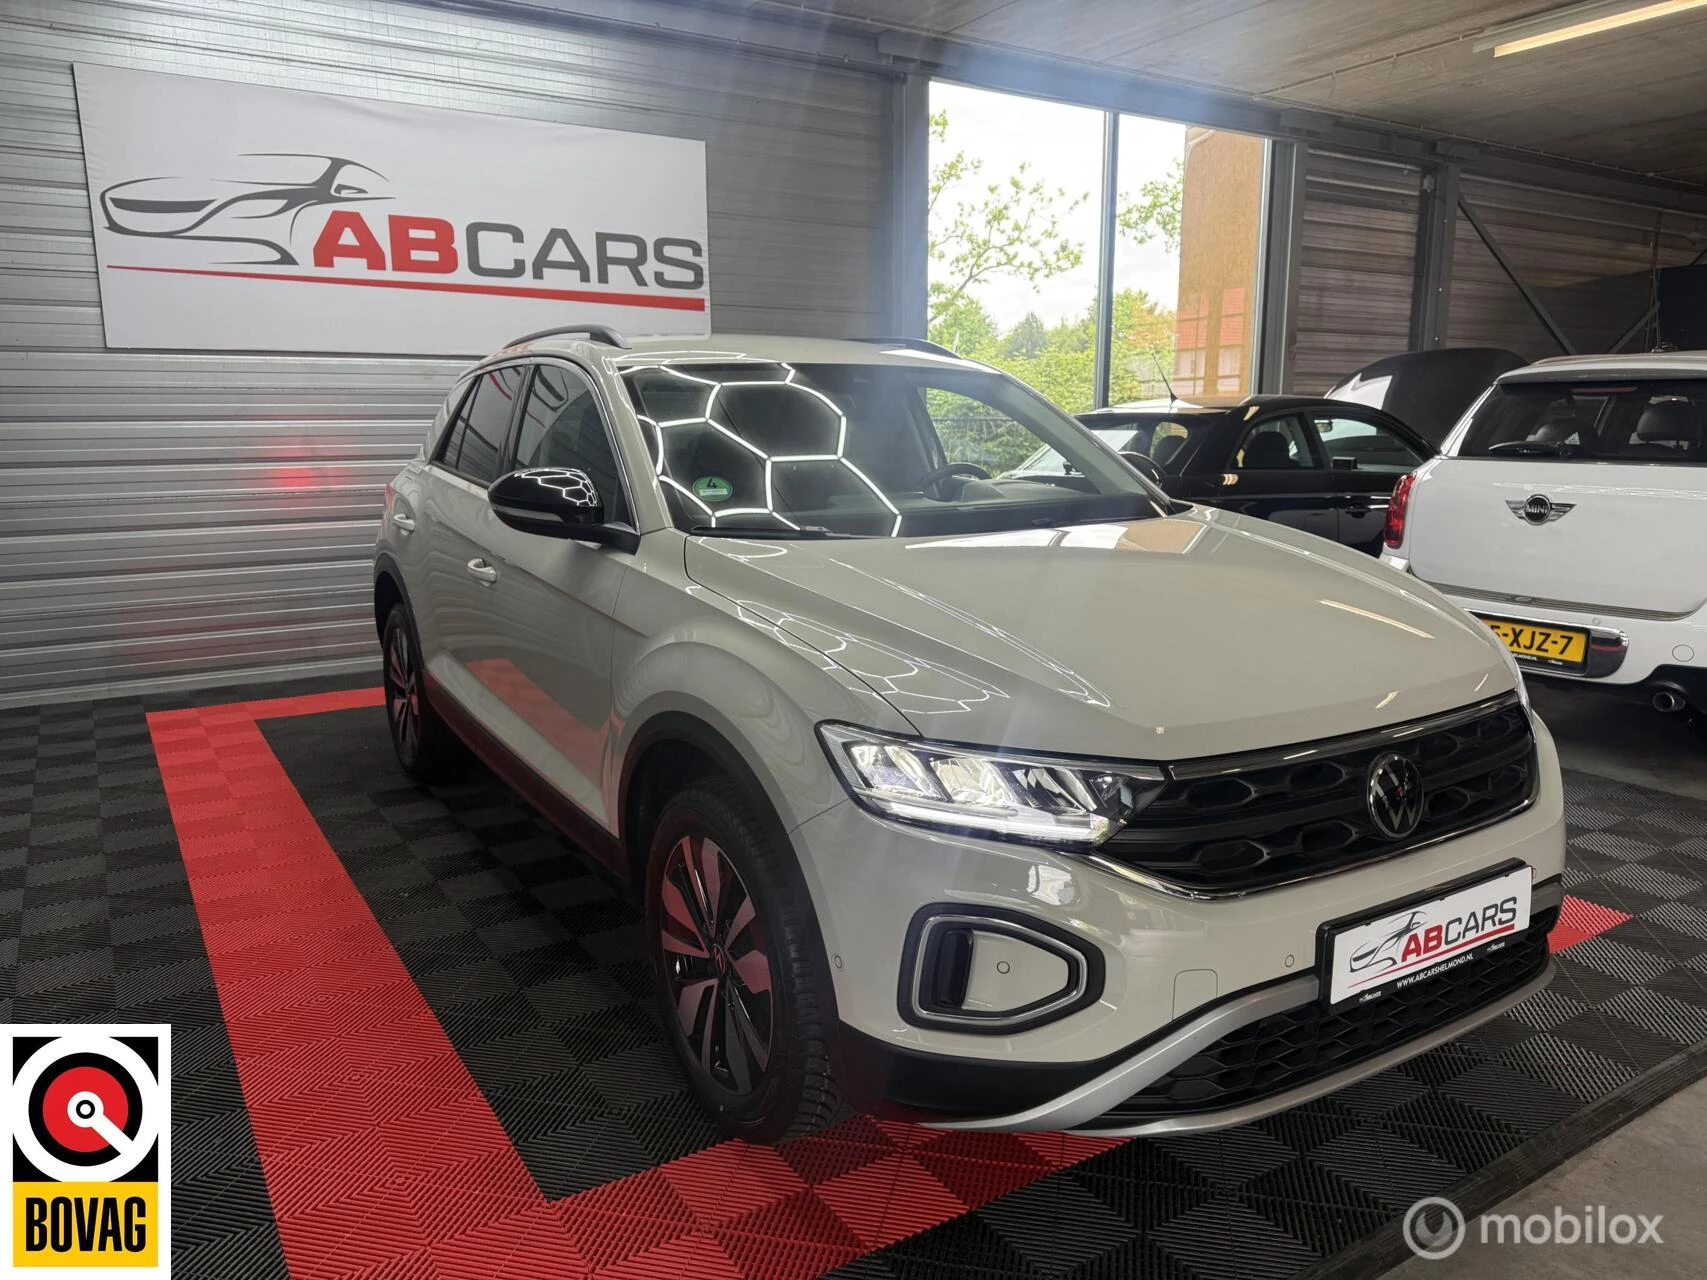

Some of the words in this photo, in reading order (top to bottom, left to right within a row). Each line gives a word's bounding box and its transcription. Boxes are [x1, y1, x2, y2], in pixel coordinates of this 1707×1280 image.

[313, 210, 704, 290] ABCARS
[706, 478, 717, 489] 4
[1525, 504, 1548, 514] MINI
[1401, 896, 1517, 963] ABCARS
[1396, 953, 1474, 989] WWW.ABCARSHELMOND.NL
